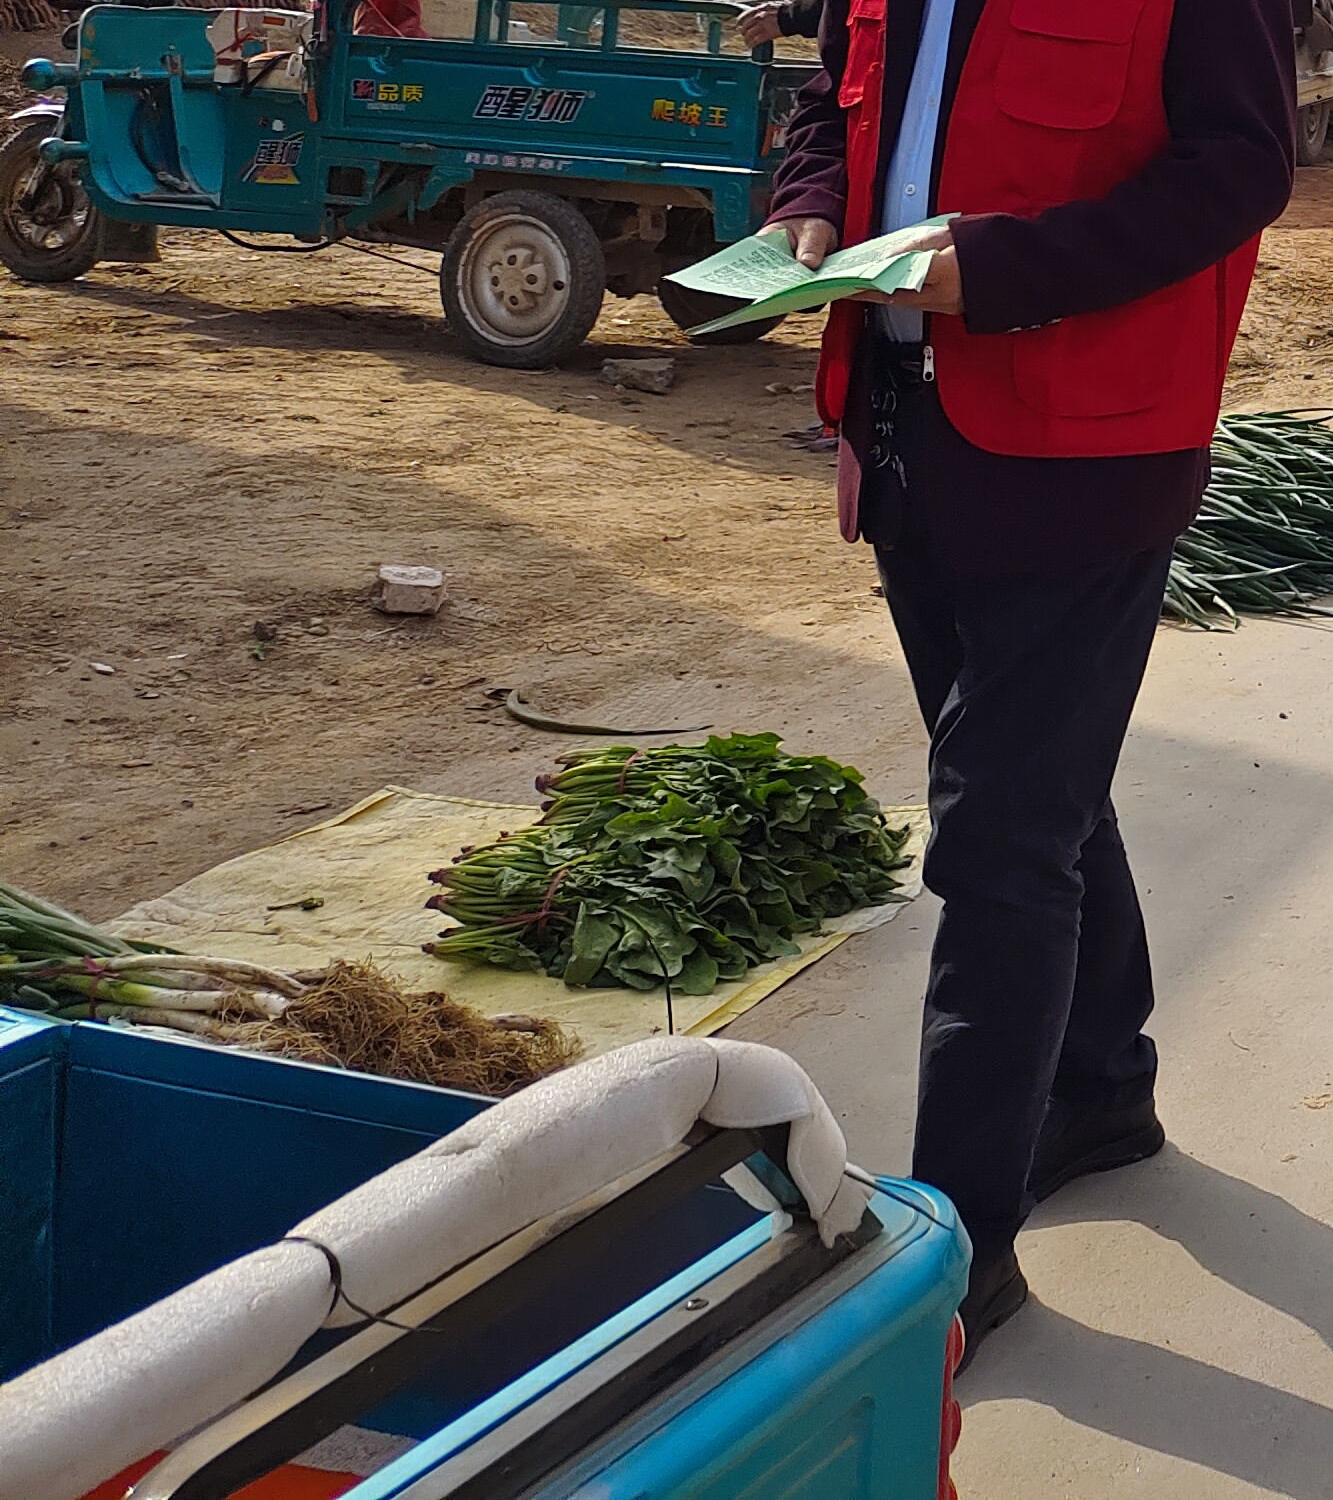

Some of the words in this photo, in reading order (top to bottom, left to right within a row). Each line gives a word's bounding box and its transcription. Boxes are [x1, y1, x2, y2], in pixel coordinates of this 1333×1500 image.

[473, 84, 589, 124] 醒狮
[651, 98, 729, 128] 爬坡王
